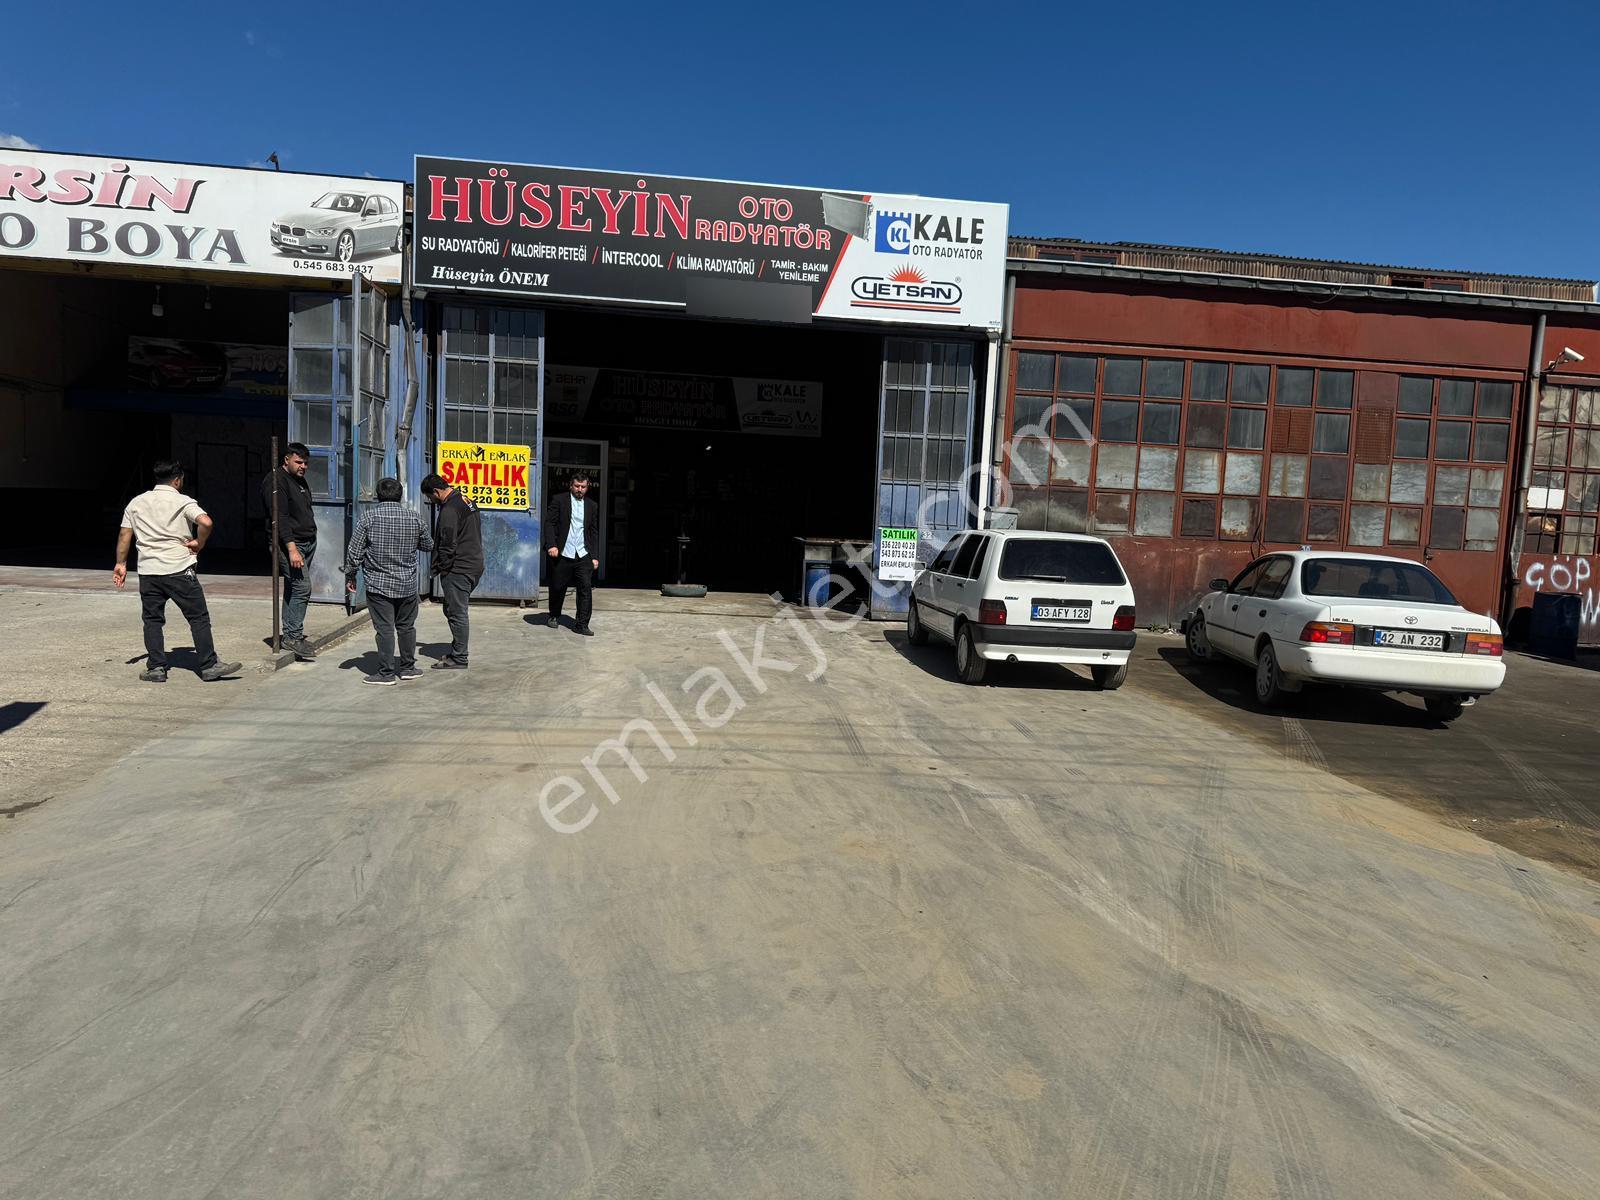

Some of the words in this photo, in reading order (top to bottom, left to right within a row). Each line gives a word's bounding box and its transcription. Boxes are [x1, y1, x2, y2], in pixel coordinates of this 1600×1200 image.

[427, 168, 692, 240] HÜSEYİN
[739, 195, 794, 222] OTO
[695, 219, 832, 250] RADYATÖR
[891, 227, 910, 243] KL
[913, 213, 985, 245] KALE
[66, 217, 248, 265] BOYA
[421, 236, 436, 250] SU
[438, 237, 500, 255] RADYATÖRÜ
[511, 242, 557, 259] KALORİFER
[558, 245, 587, 262] PETEĞİ
[602, 247, 664, 268] İNTERCOOL
[676, 254, 703, 271] KLİMA
[704, 256, 755, 275] RADYATÖRÜ
[912, 244, 932, 257] OTO
[934, 246, 983, 260] RADYATÖR
[293, 260, 323, 270] 0.545
[325, 262, 345, 272] 683
[347, 264, 374, 274] 9437
[771, 259, 796, 270] TAMİR
[802, 262, 829, 273] BAKIM
[431, 265, 496, 284] Hüseyin
[499, 267, 550, 287] ÖNEM
[779, 270, 820, 283] YENİLEME
[861, 282, 952, 299] YETSAN
[442, 446, 486, 462] ERKAM
[489, 451, 527, 463] EMLAK
[441, 461, 527, 487] SATILIK
[472, 486, 493, 495] 873
[496, 487, 509, 496] 62
[513, 488, 526, 497] 16
[472, 495, 493, 504] 220
[495, 496, 510, 505] 40
[513, 497, 527, 506] 28
[882, 529, 916, 539] SATILIK
[881, 540, 891, 549] 536
[891, 541, 901, 549] 220
[902, 541, 909, 550] 40
[881, 549, 891, 558] 543
[902, 550, 908, 559] 62
[1038, 607, 1050, 617] 03
[1051, 608, 1070, 618] AFY
[1073, 608, 1089, 618] 128
[1381, 633, 1395, 644] 42
[1400, 634, 1415, 645] AN
[1420, 635, 1442, 647] 232
